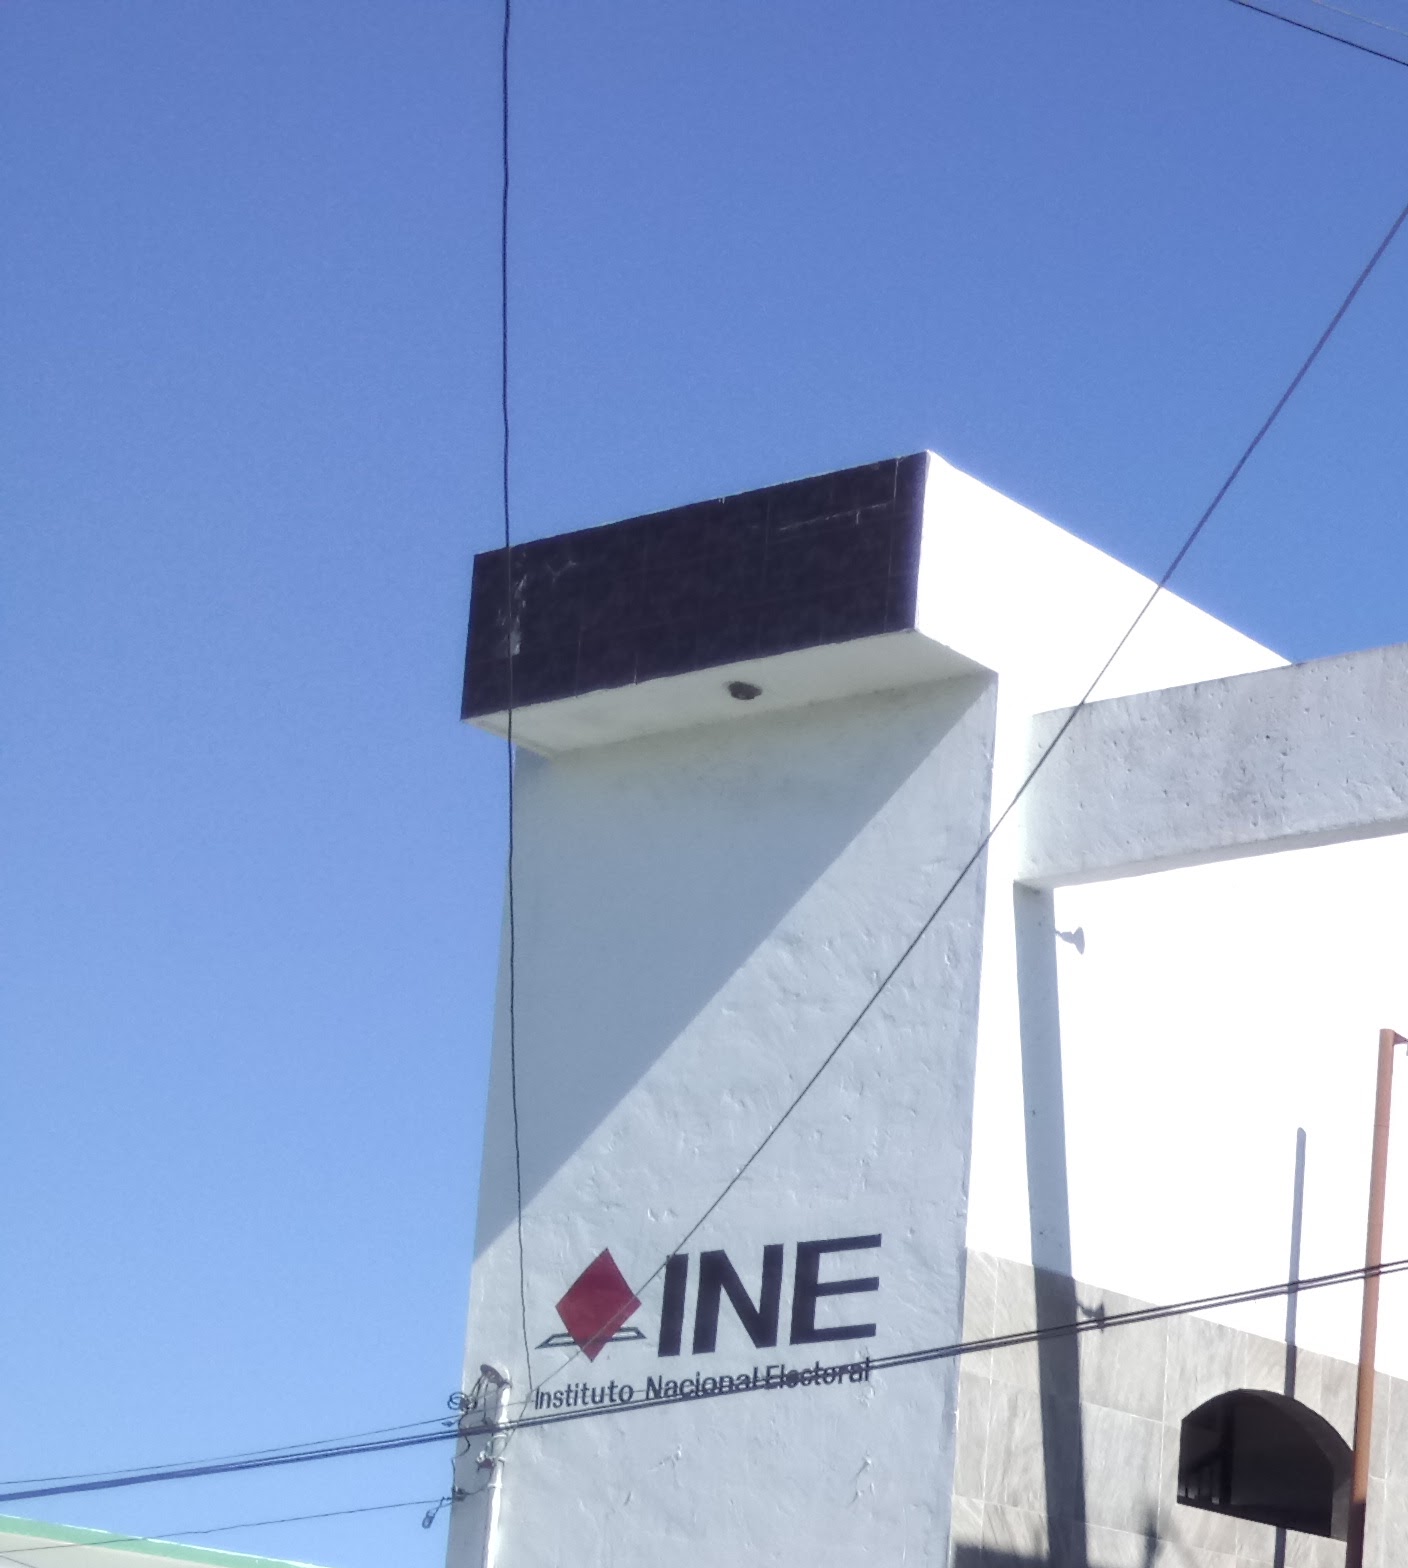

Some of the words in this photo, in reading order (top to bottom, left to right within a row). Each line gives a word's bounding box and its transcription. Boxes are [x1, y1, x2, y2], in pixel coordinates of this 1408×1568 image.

[658, 1233, 882, 1357] INE
[534, 1377, 633, 1410] Instituto
[645, 1367, 758, 1400] Nacional
[764, 1357, 871, 1390] Electoral
